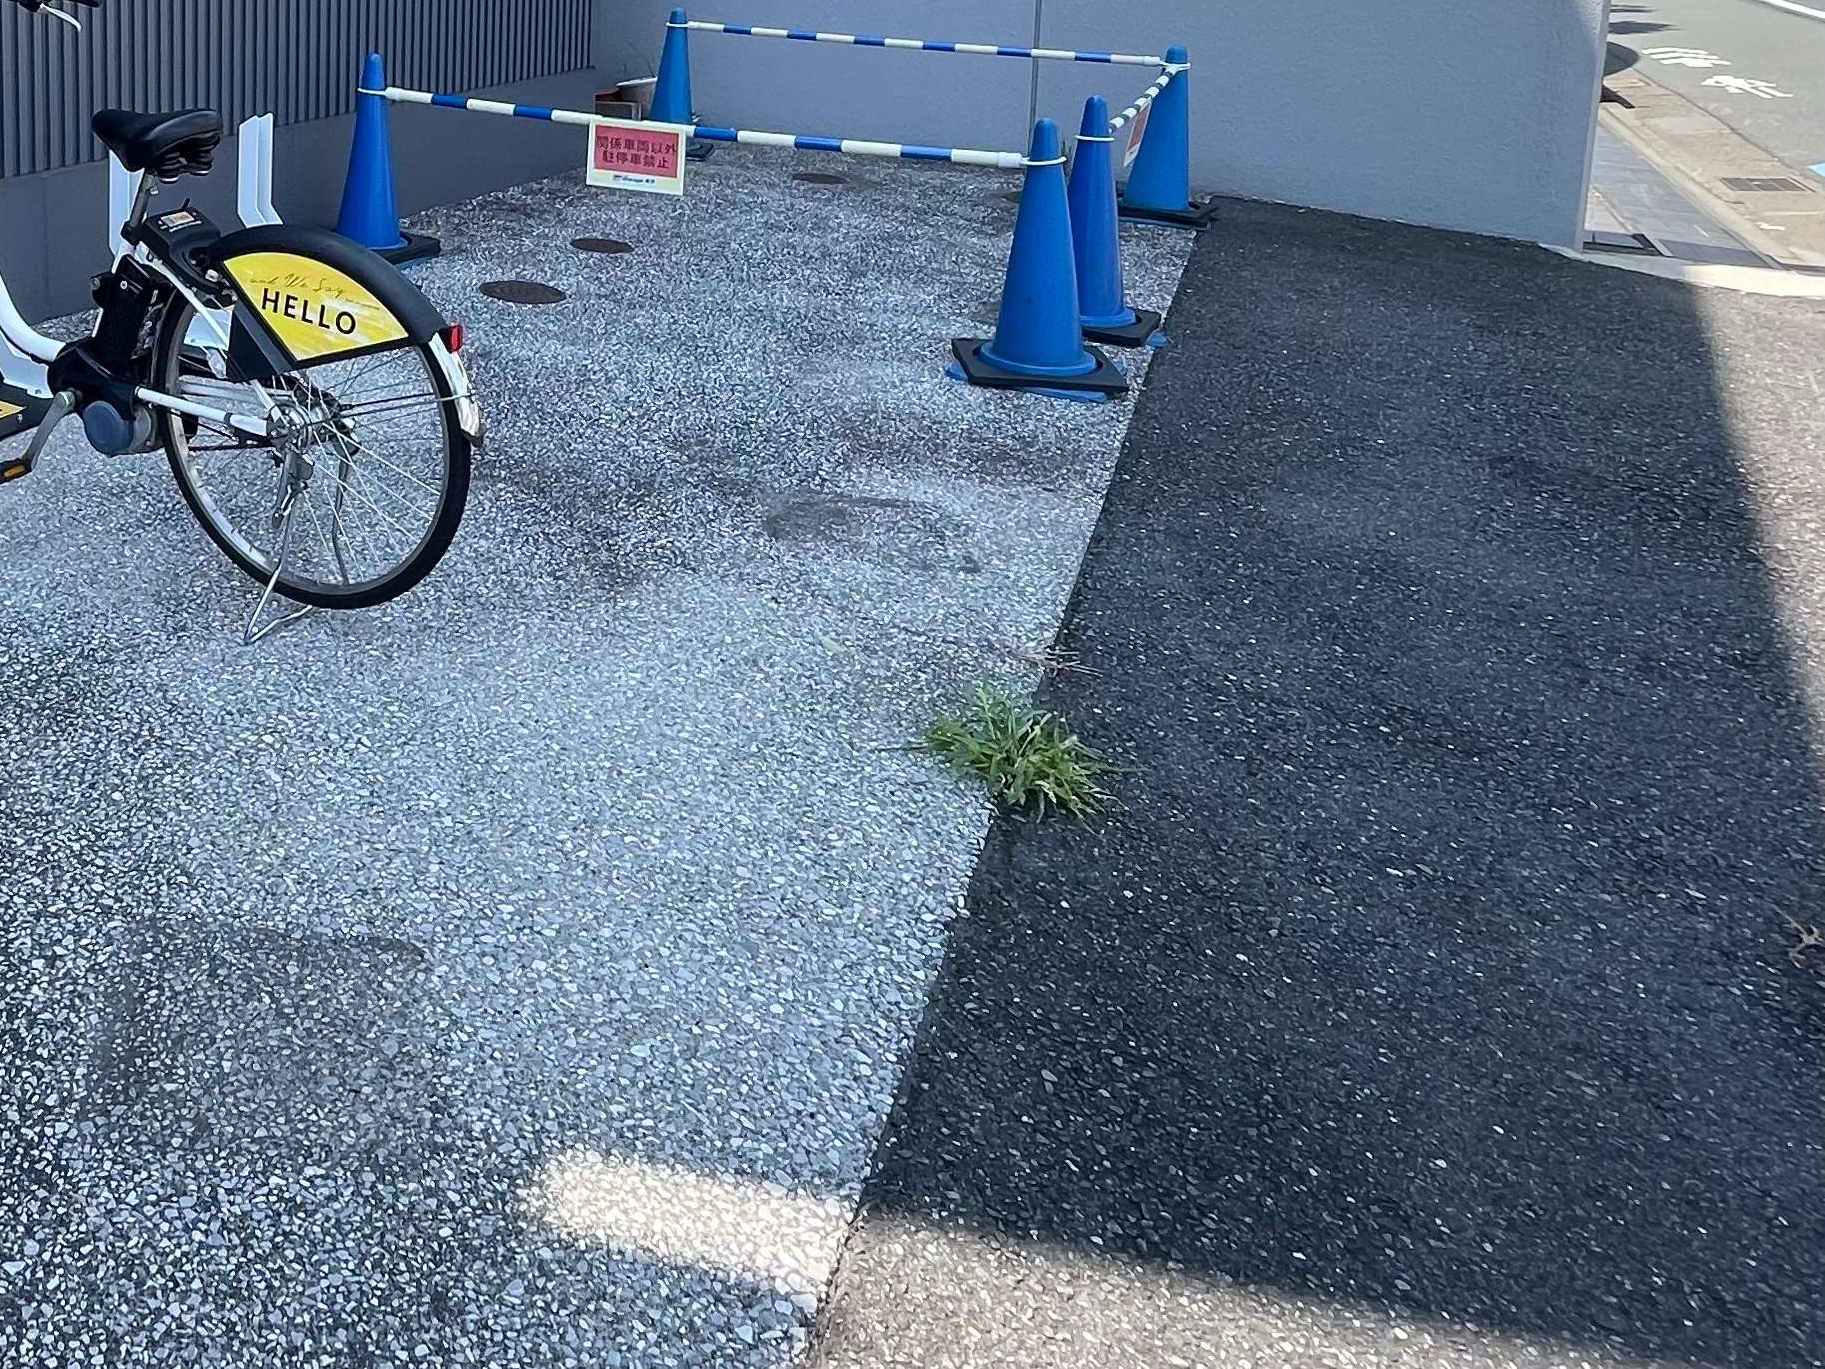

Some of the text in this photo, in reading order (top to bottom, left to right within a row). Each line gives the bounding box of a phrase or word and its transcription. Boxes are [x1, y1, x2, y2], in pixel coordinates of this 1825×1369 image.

[596, 135, 678, 156] 関係車両以外
[602, 149, 670, 169] 駐停車禁止
[261, 287, 357, 335] HELLO
